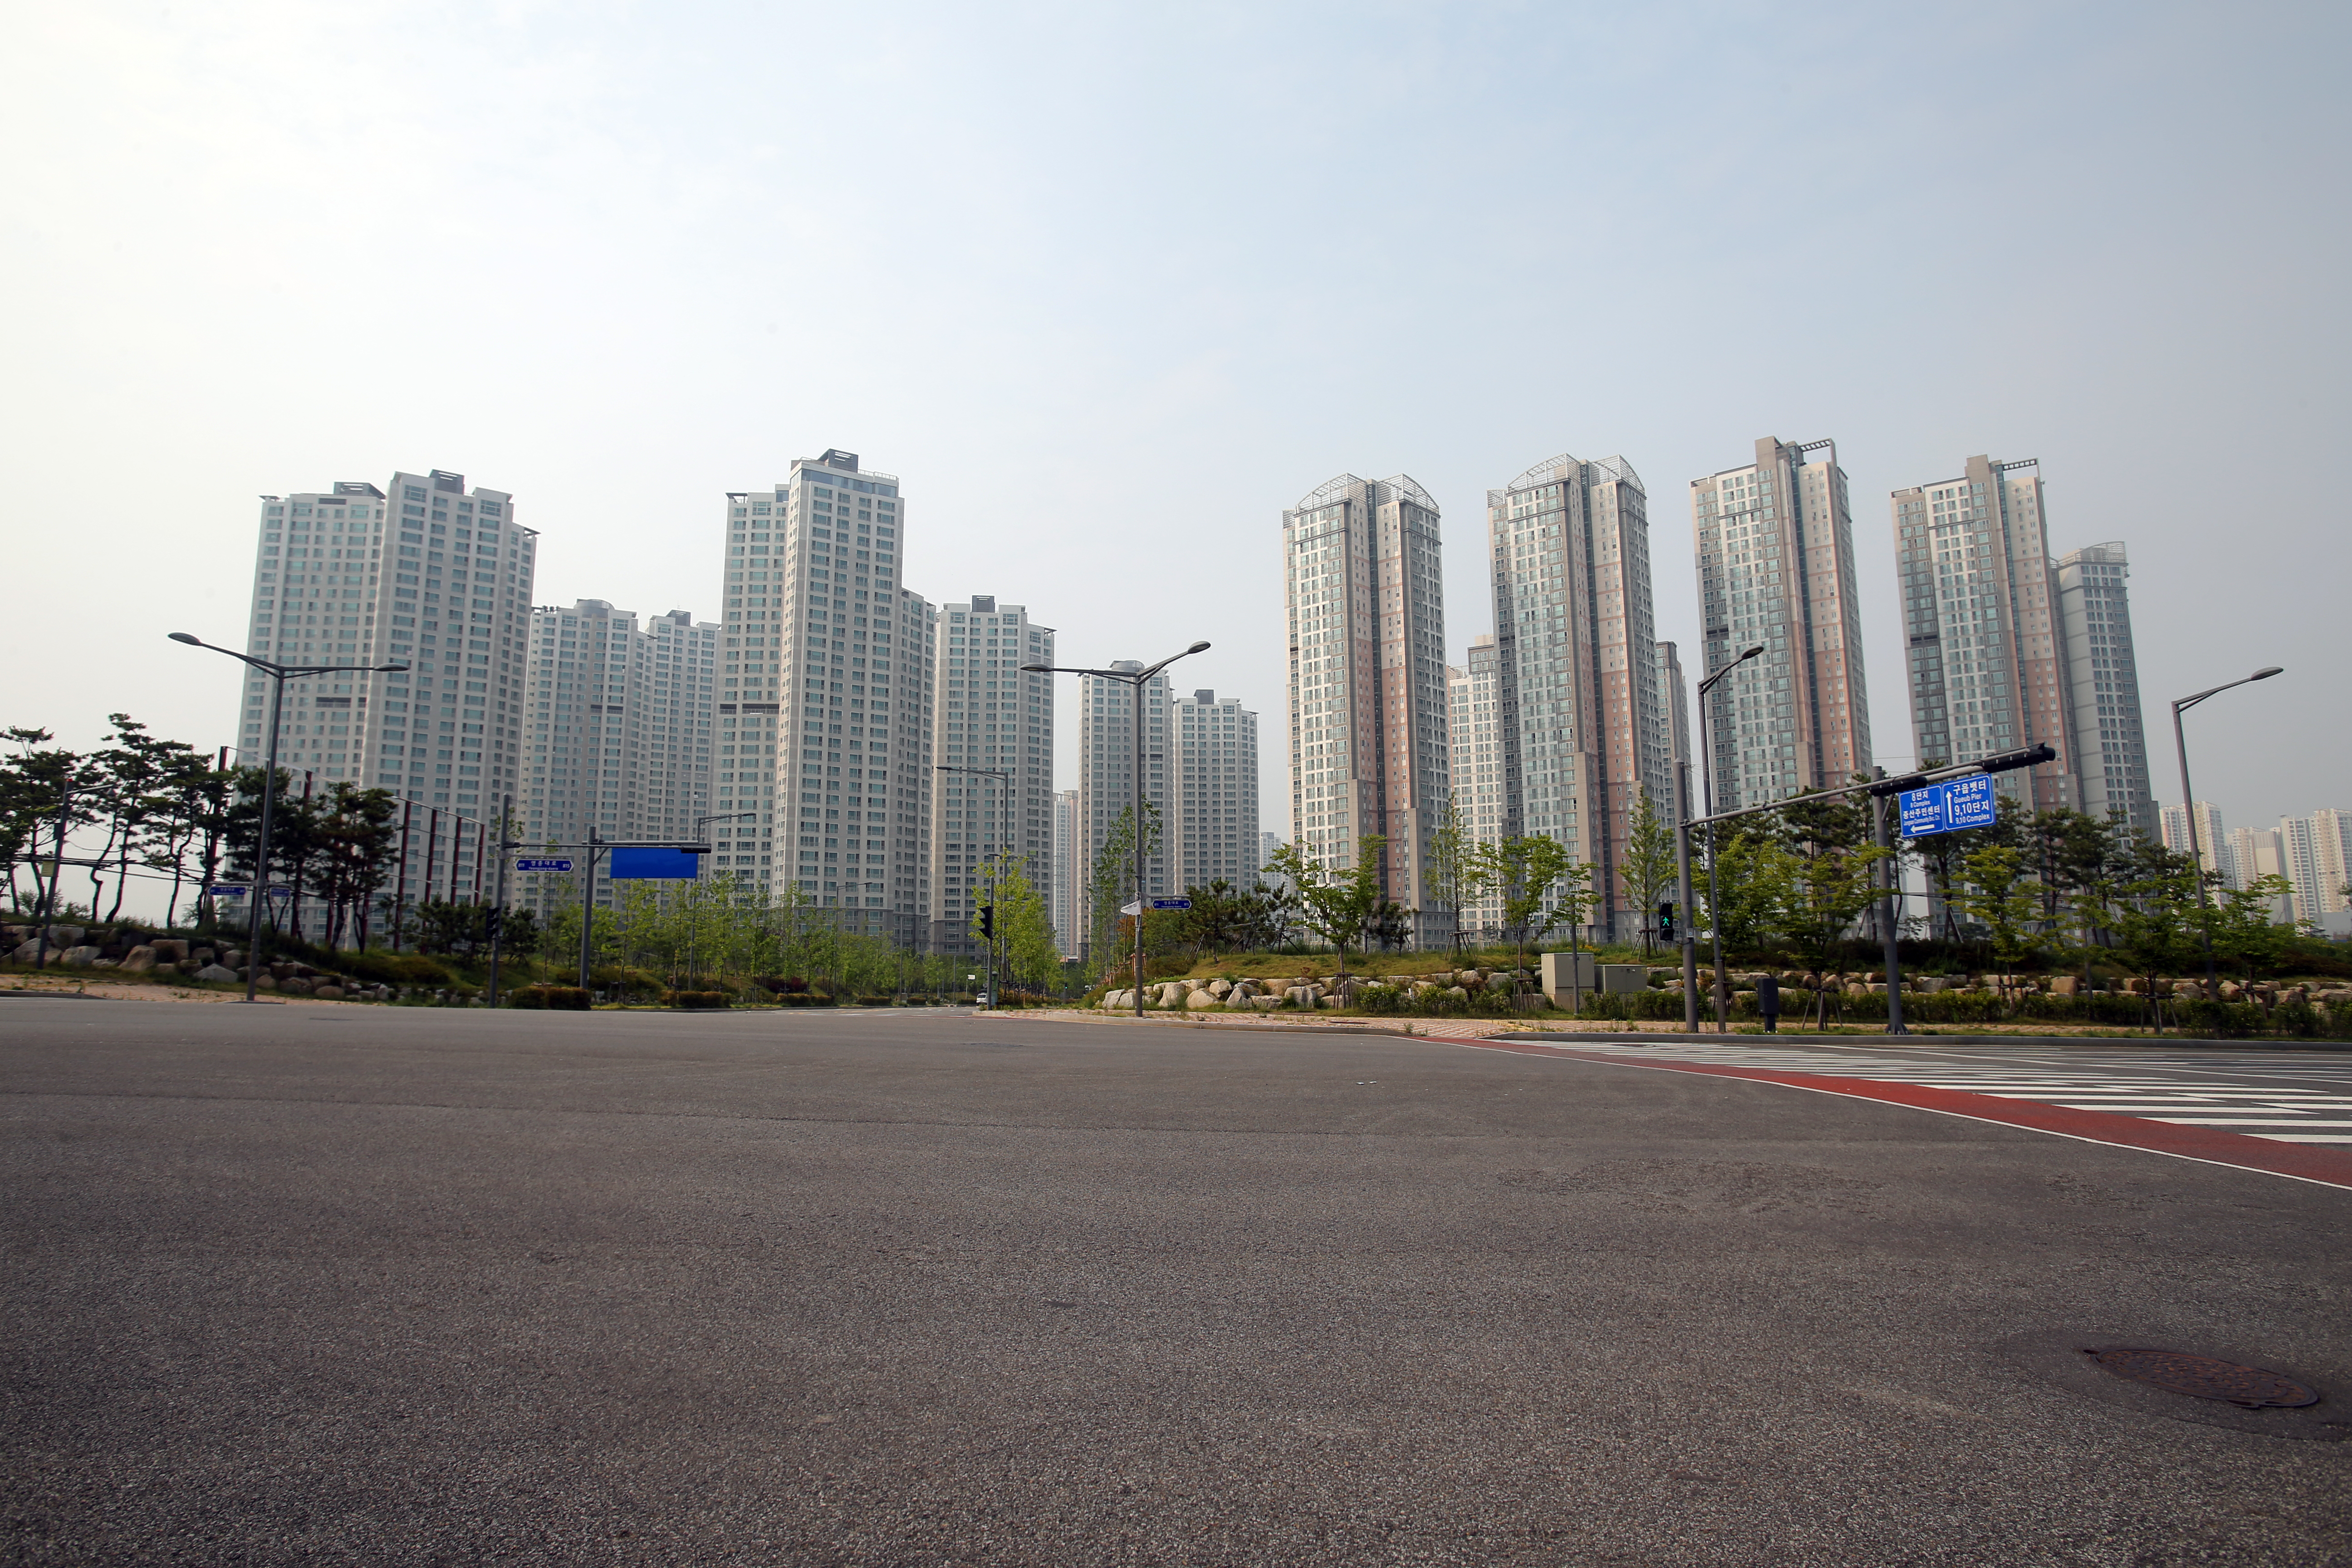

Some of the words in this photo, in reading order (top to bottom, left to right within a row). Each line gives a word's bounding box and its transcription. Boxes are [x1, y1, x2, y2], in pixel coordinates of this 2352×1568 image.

[1911, 790, 1928, 801] 8단지
[1954, 795, 1970, 804] Gueub
[1954, 799, 1989, 816] 9,10단지
[1955, 816, 1966, 824] 9,10
[1966, 813, 1990, 822] Complex
